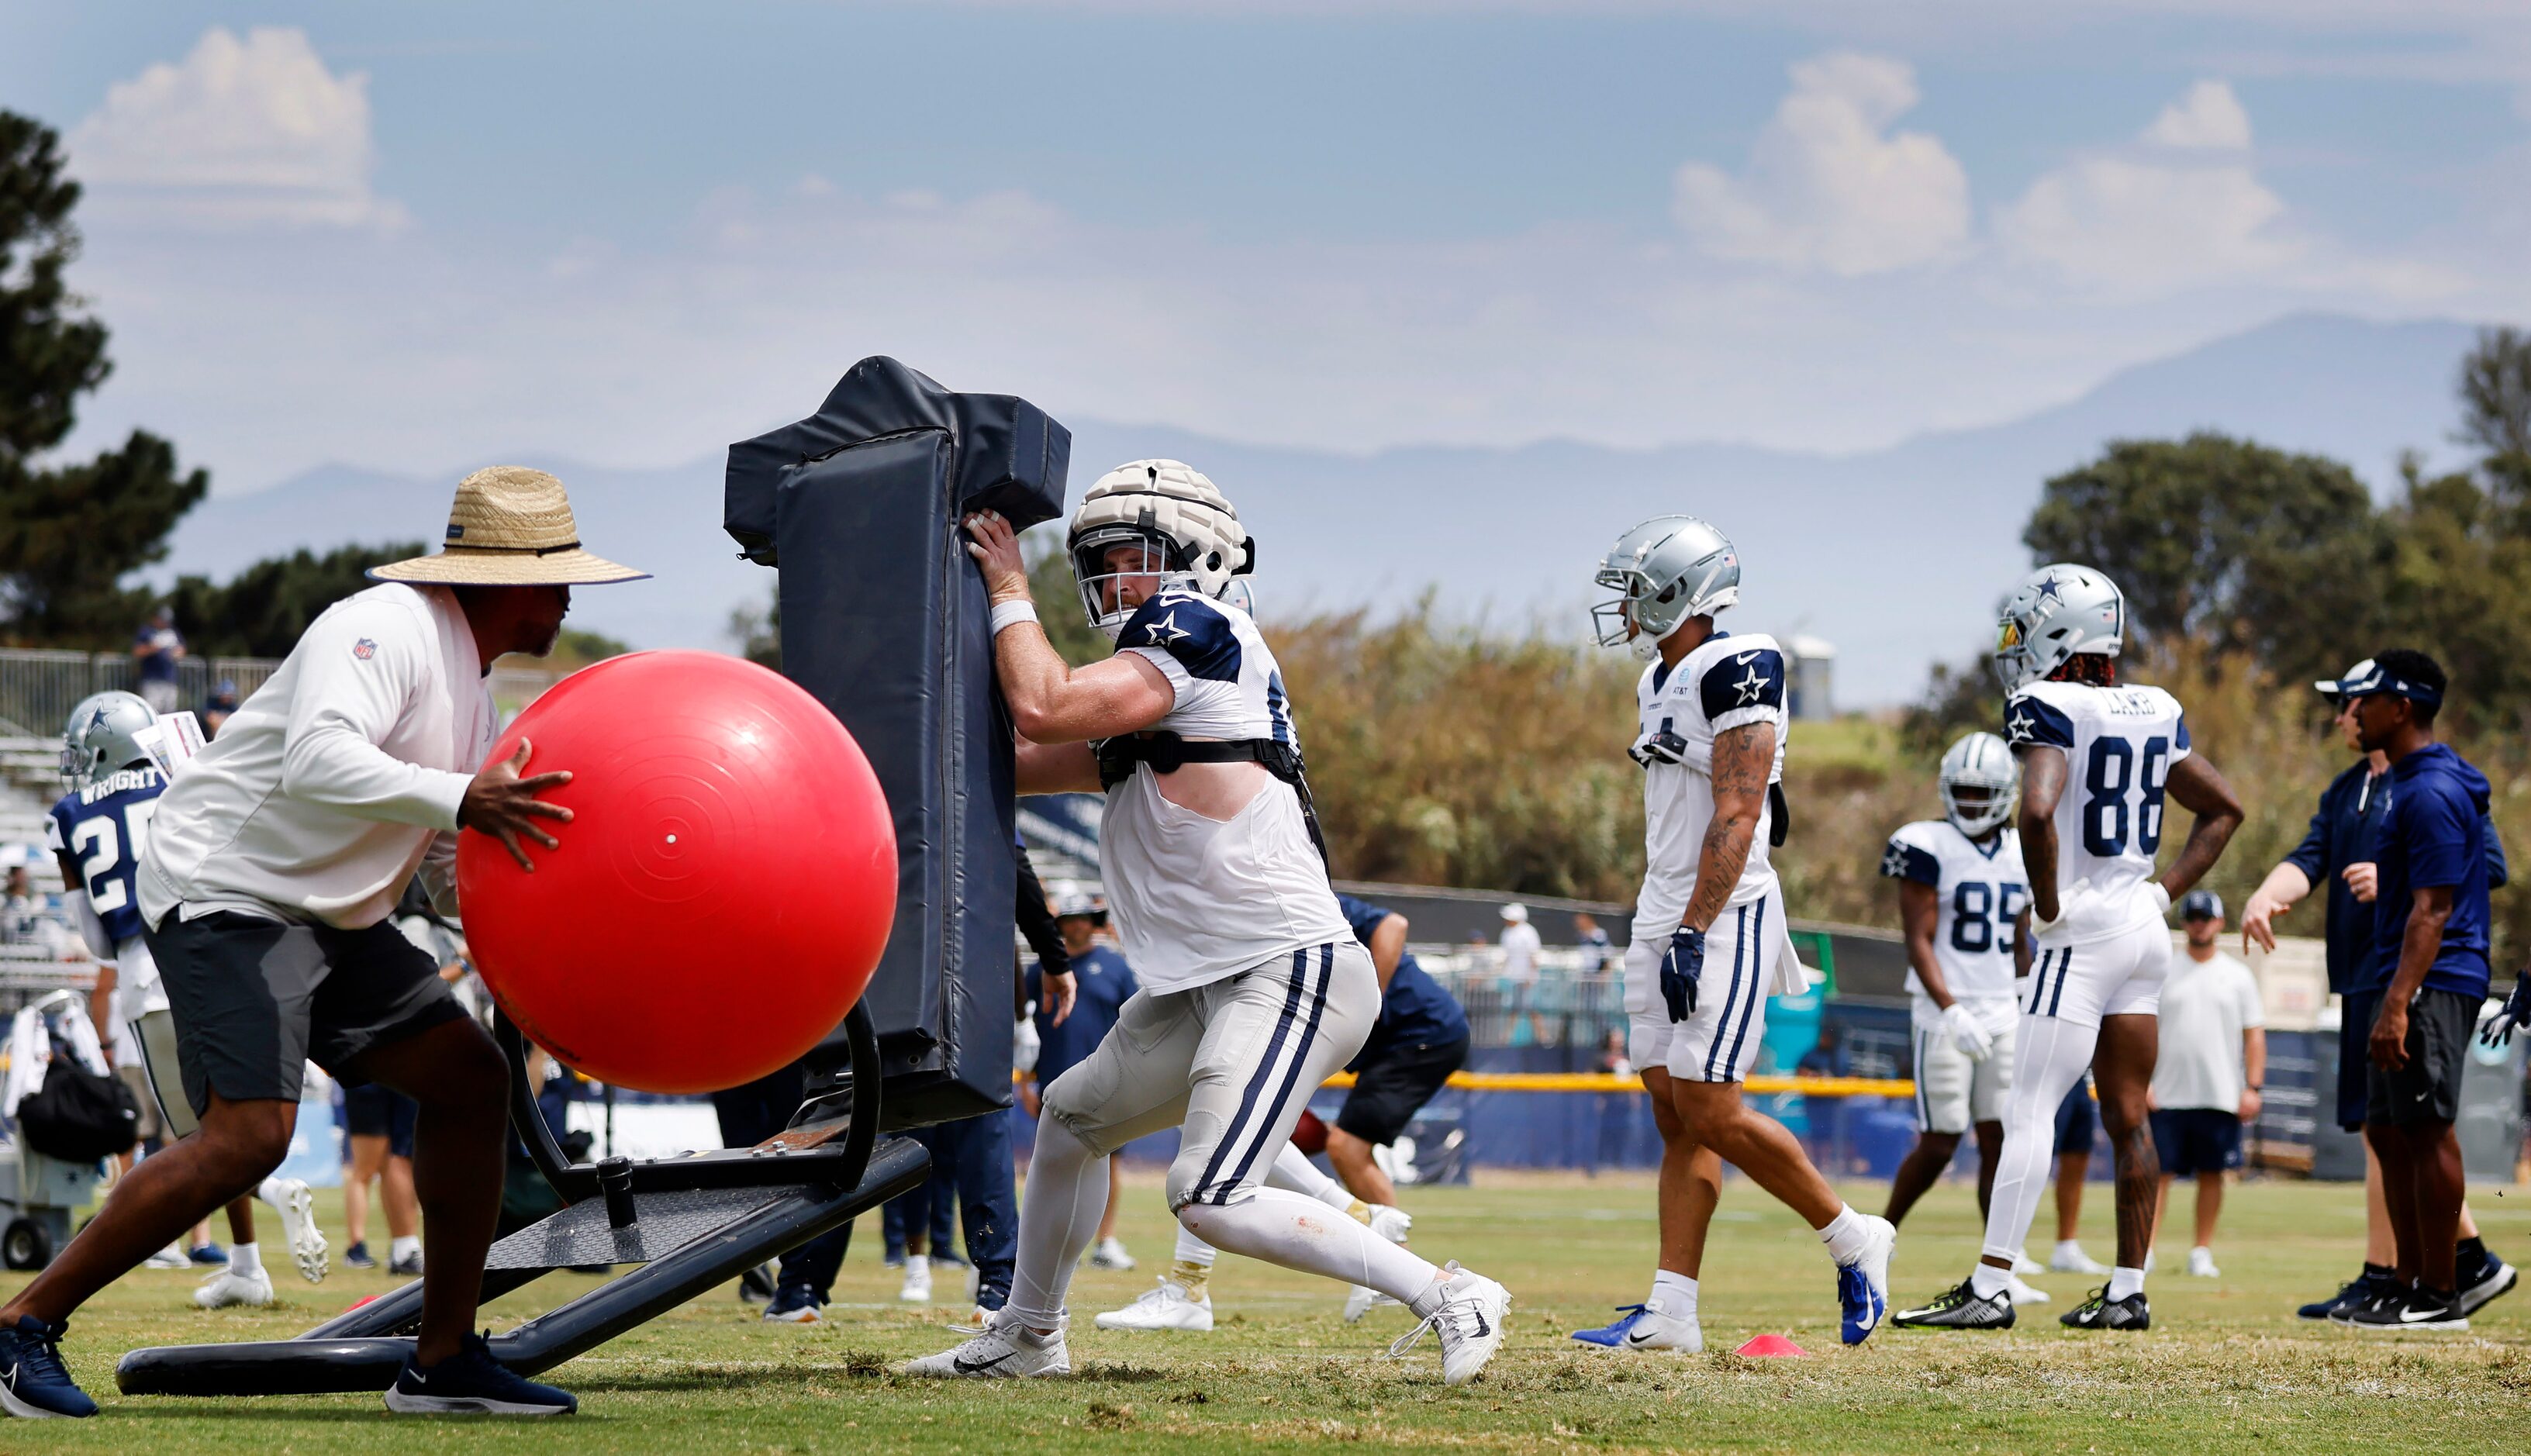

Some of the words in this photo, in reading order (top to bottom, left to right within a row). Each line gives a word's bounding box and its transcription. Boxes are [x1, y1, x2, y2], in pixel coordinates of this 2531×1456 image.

[355, 643, 372, 658] NFL
[1673, 687, 1688, 695] AT&T
[2101, 689, 2156, 715] LAMB
[80, 766, 159, 806] WRIGHT
[2084, 736, 2168, 856] 88
[1952, 882, 2022, 953] 85
